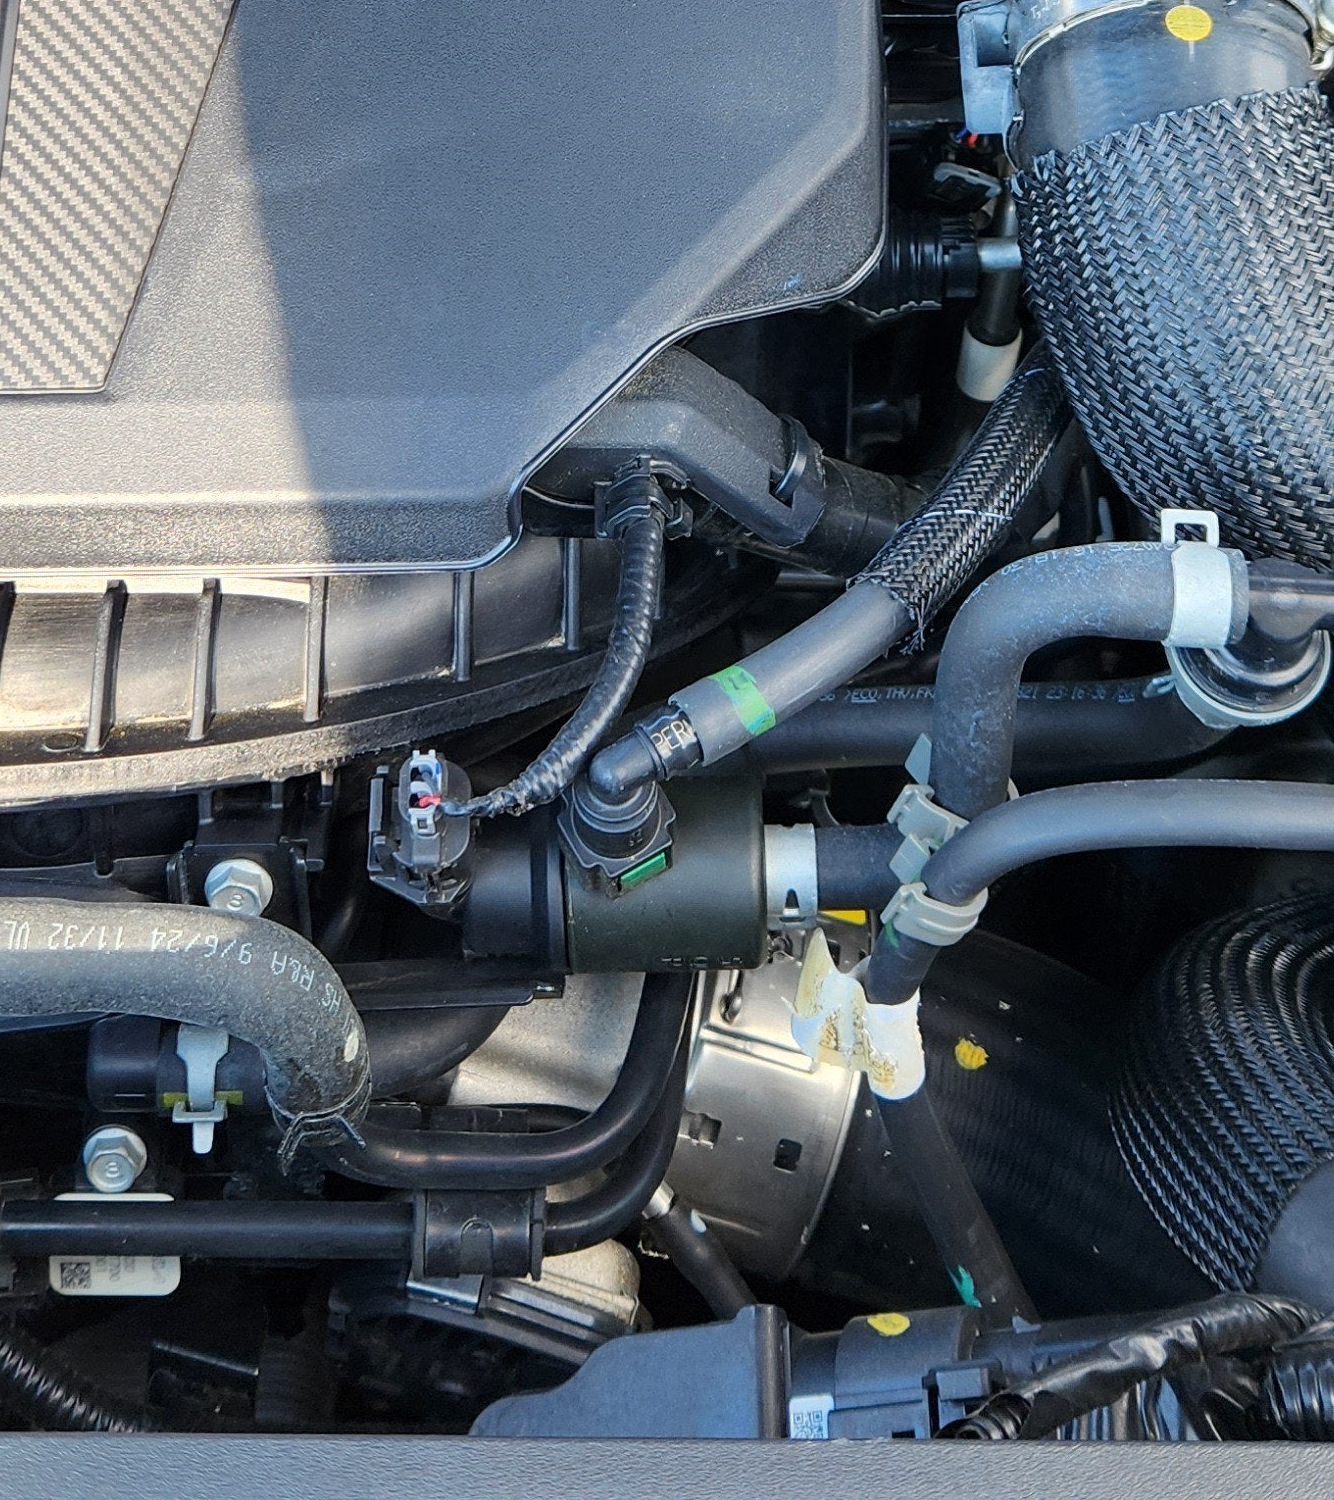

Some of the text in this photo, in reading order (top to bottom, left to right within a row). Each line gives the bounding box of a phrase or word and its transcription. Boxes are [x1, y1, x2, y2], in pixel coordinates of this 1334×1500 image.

[47, 921, 126, 953] 11/32
[150, 927, 253, 966] 9/6/24
[269, 951, 315, 993] R&A
